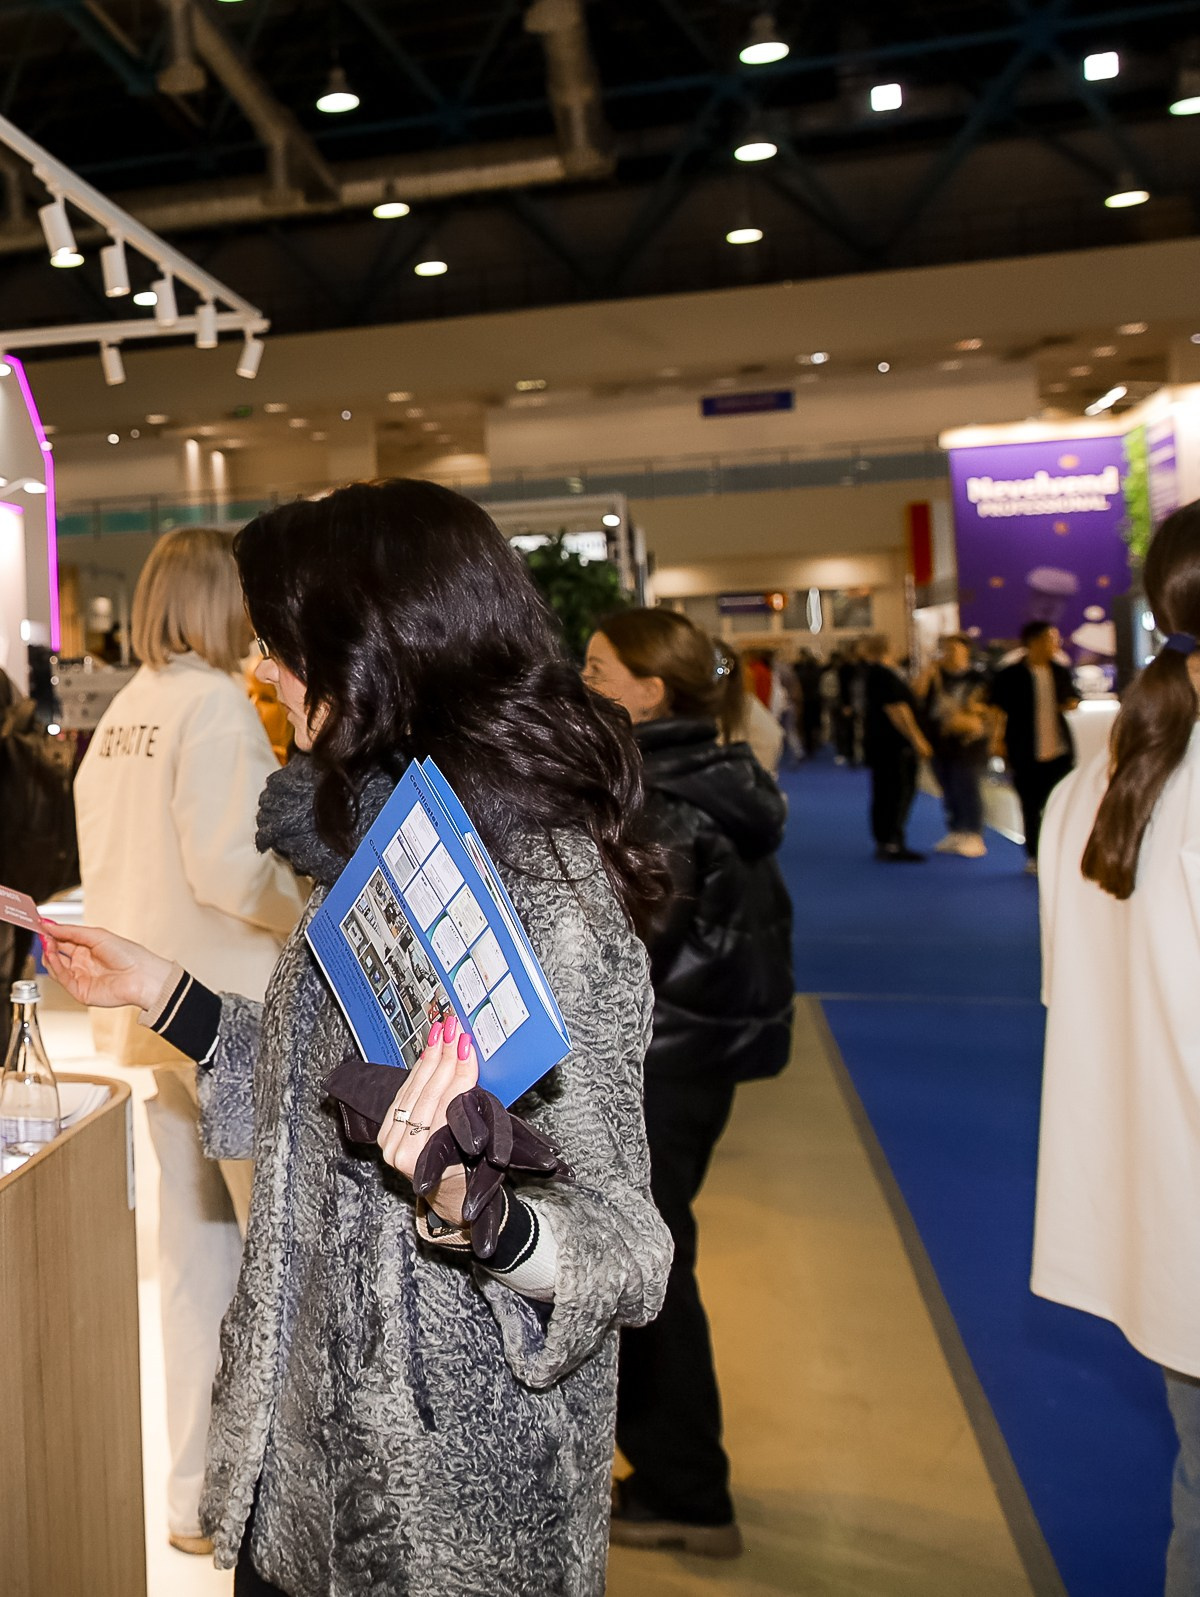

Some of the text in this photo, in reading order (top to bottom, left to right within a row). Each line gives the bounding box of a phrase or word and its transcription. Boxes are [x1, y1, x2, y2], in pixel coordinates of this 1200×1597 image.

[409, 774, 439, 828] Certificates
[369, 839, 406, 911] Customer Cases
